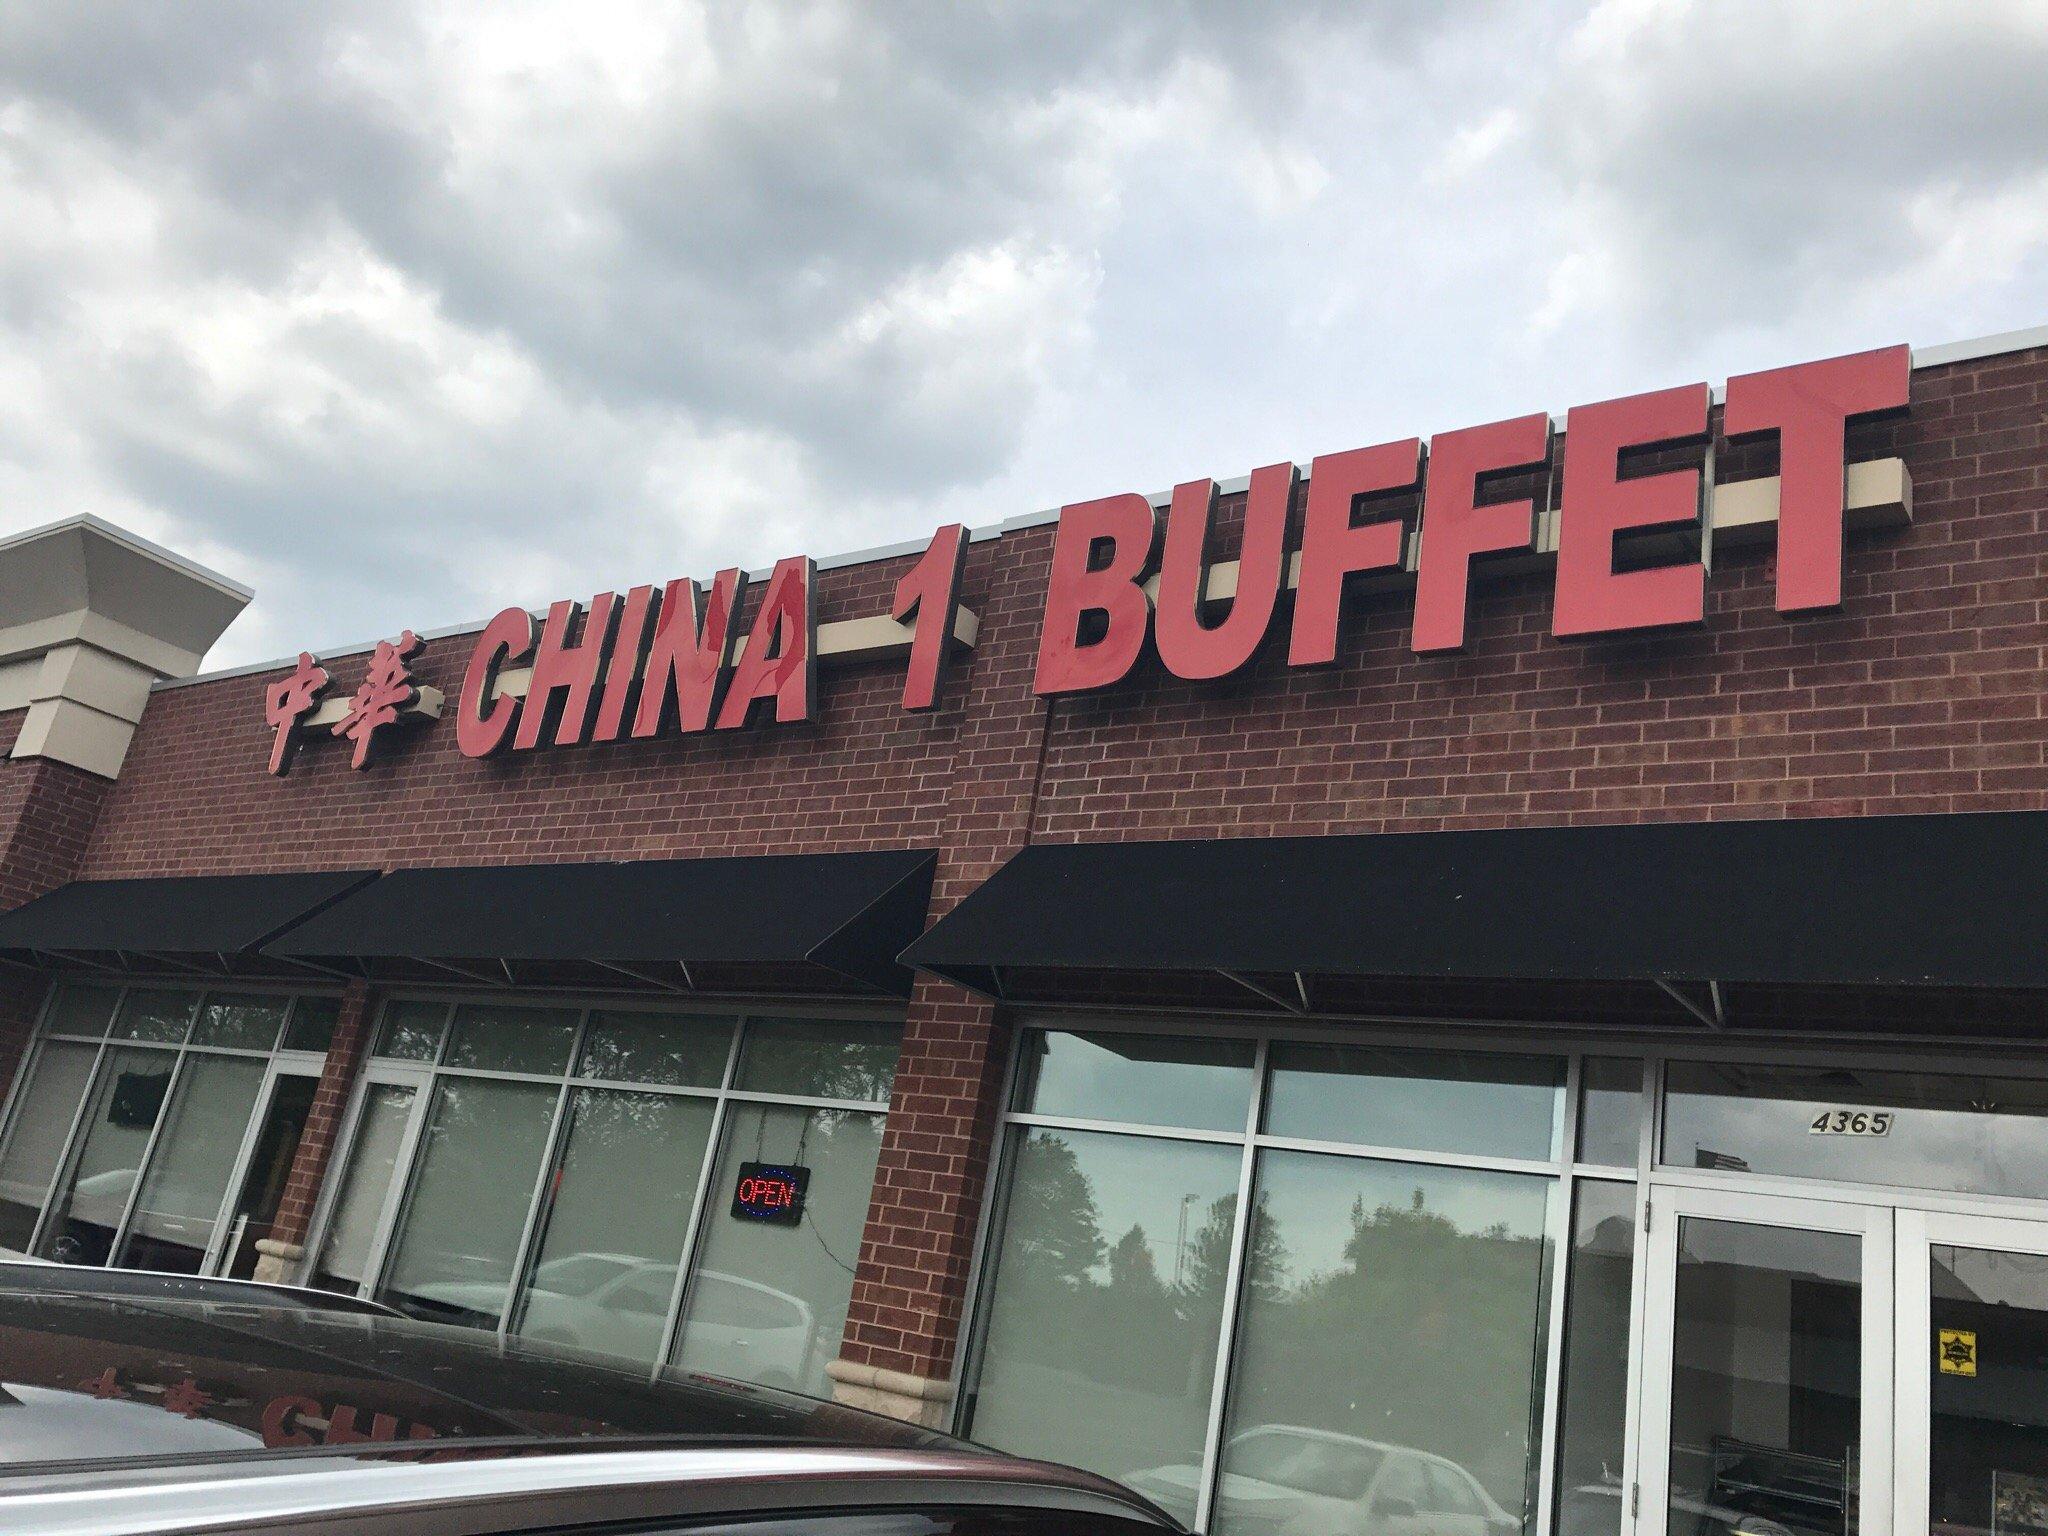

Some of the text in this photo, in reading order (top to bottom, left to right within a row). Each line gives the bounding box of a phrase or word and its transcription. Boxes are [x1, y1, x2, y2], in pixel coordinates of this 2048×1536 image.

[456, 344, 1911, 758] CHINA 1 BUFFET
[1811, 1111, 1890, 1135] 4365
[739, 1178, 796, 1207] OPEN
